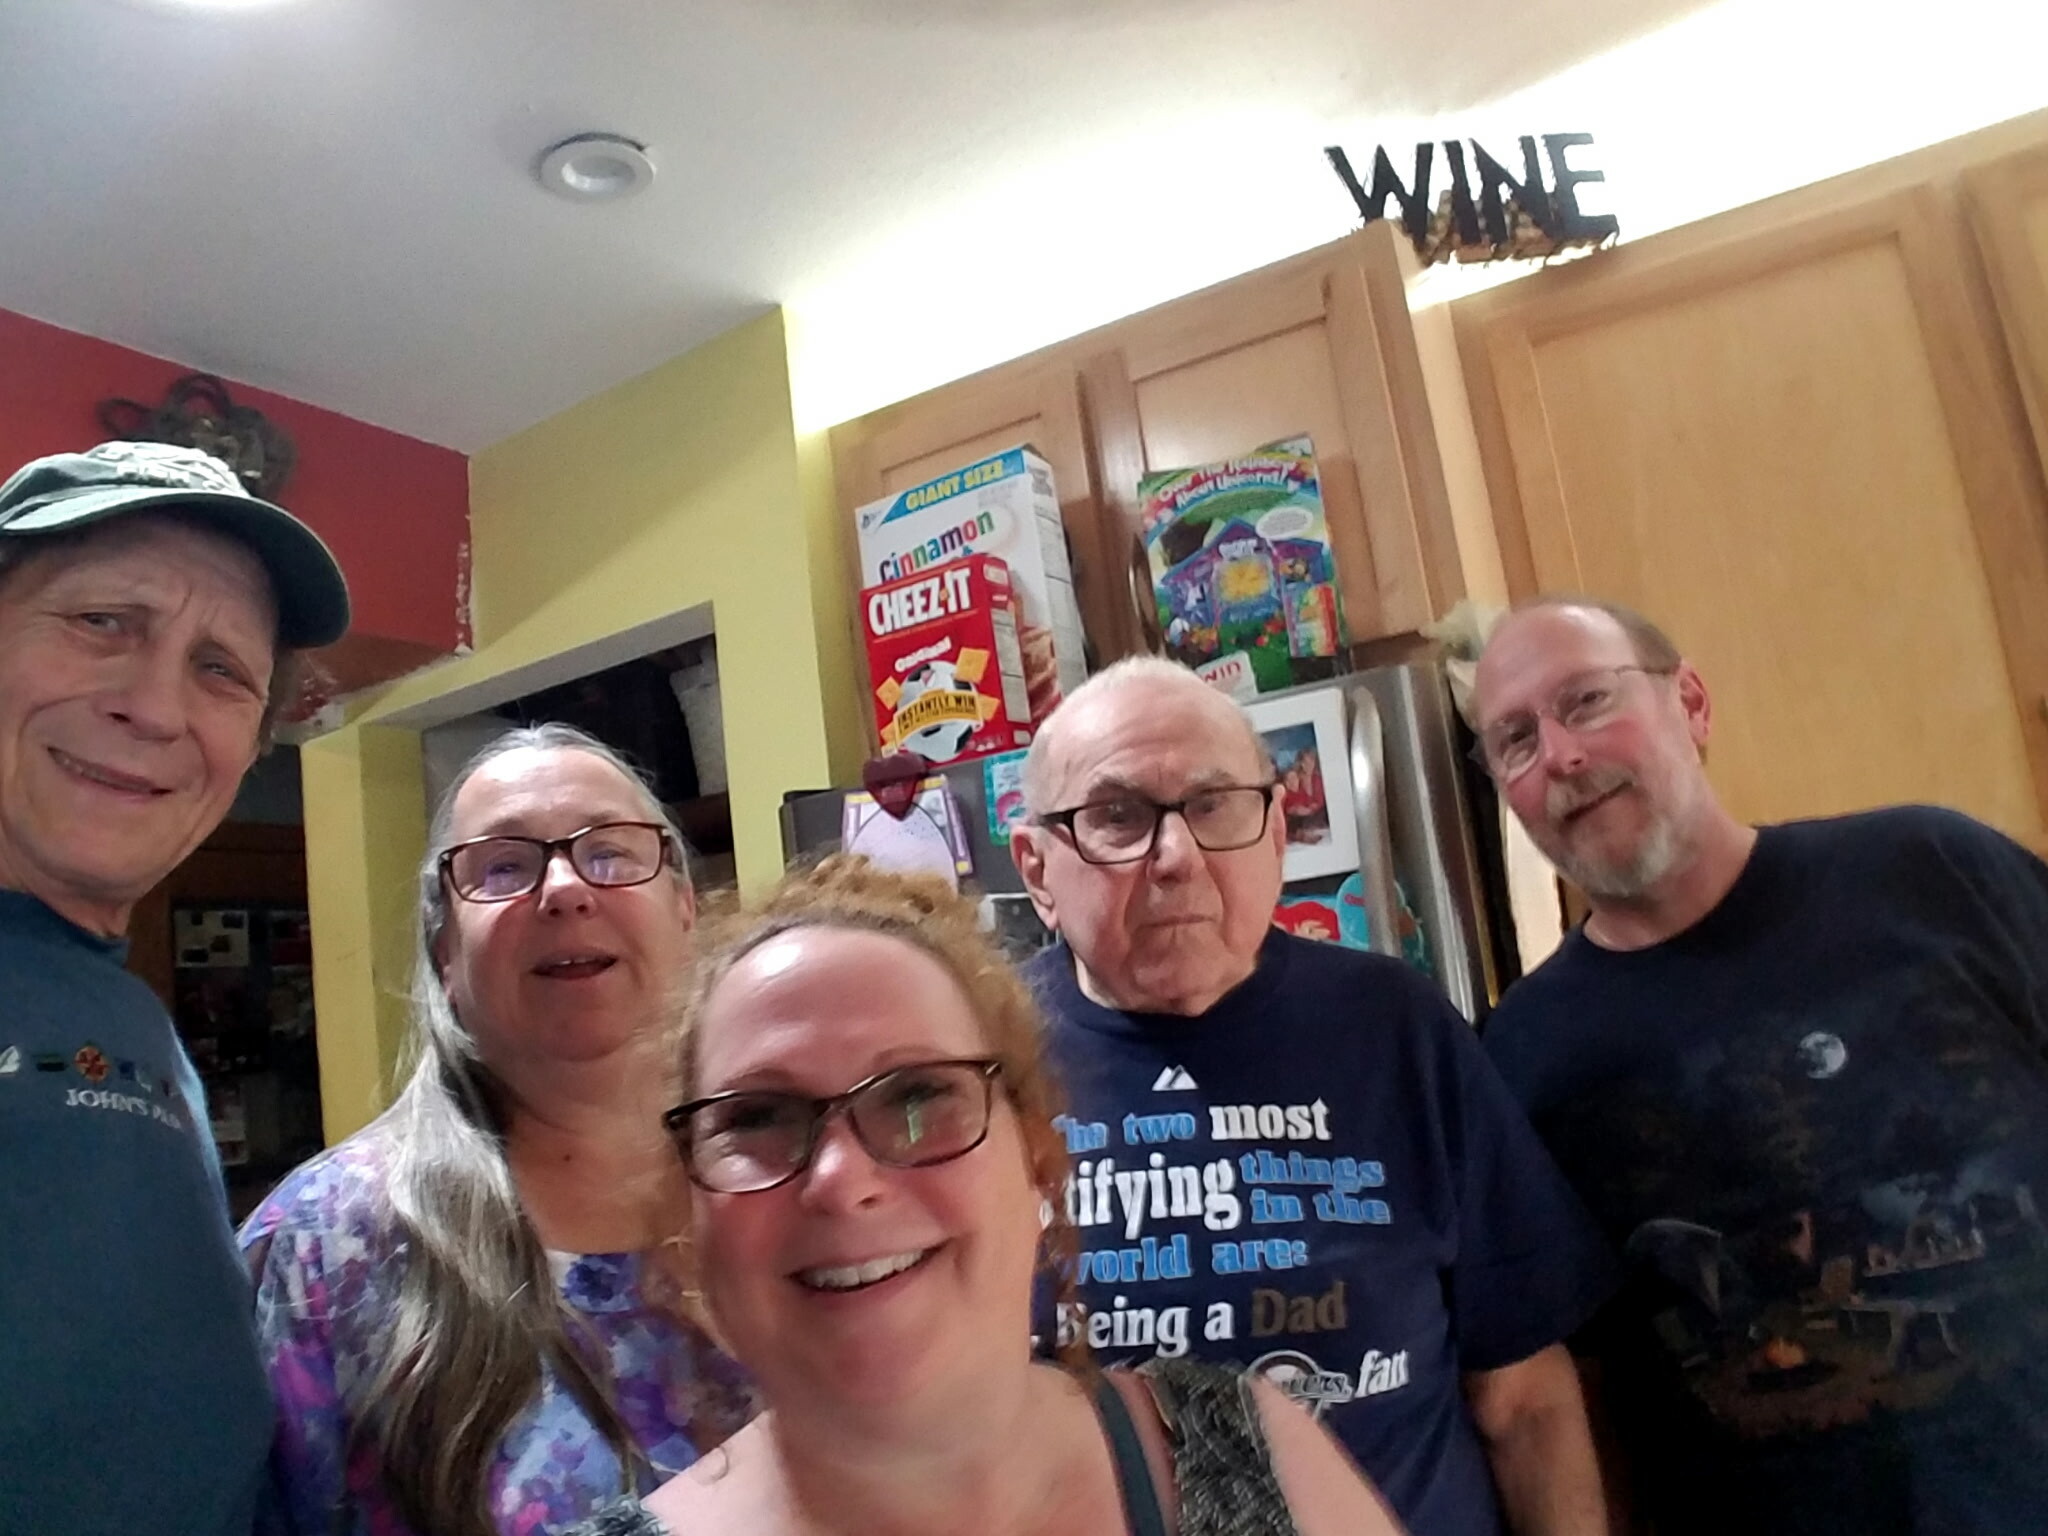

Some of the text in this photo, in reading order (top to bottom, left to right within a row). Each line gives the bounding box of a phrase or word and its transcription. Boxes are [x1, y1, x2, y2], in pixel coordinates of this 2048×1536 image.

[1323, 133, 1619, 246] WINE
[905, 477, 959, 510] GIANT
[964, 459, 1004, 488] SIZE
[879, 510, 995, 583] cinnamon
[1122, 1112, 1196, 1144] two
[1209, 1098, 1332, 1141] most
[1239, 1150, 1385, 1193] things
[1250, 1189, 1391, 1224] in the
[1211, 1238, 1309, 1275] are:
[1204, 1301, 1234, 1340] a
[1251, 1280, 1348, 1337] Dad
[1354, 1349, 1410, 1399] fan
